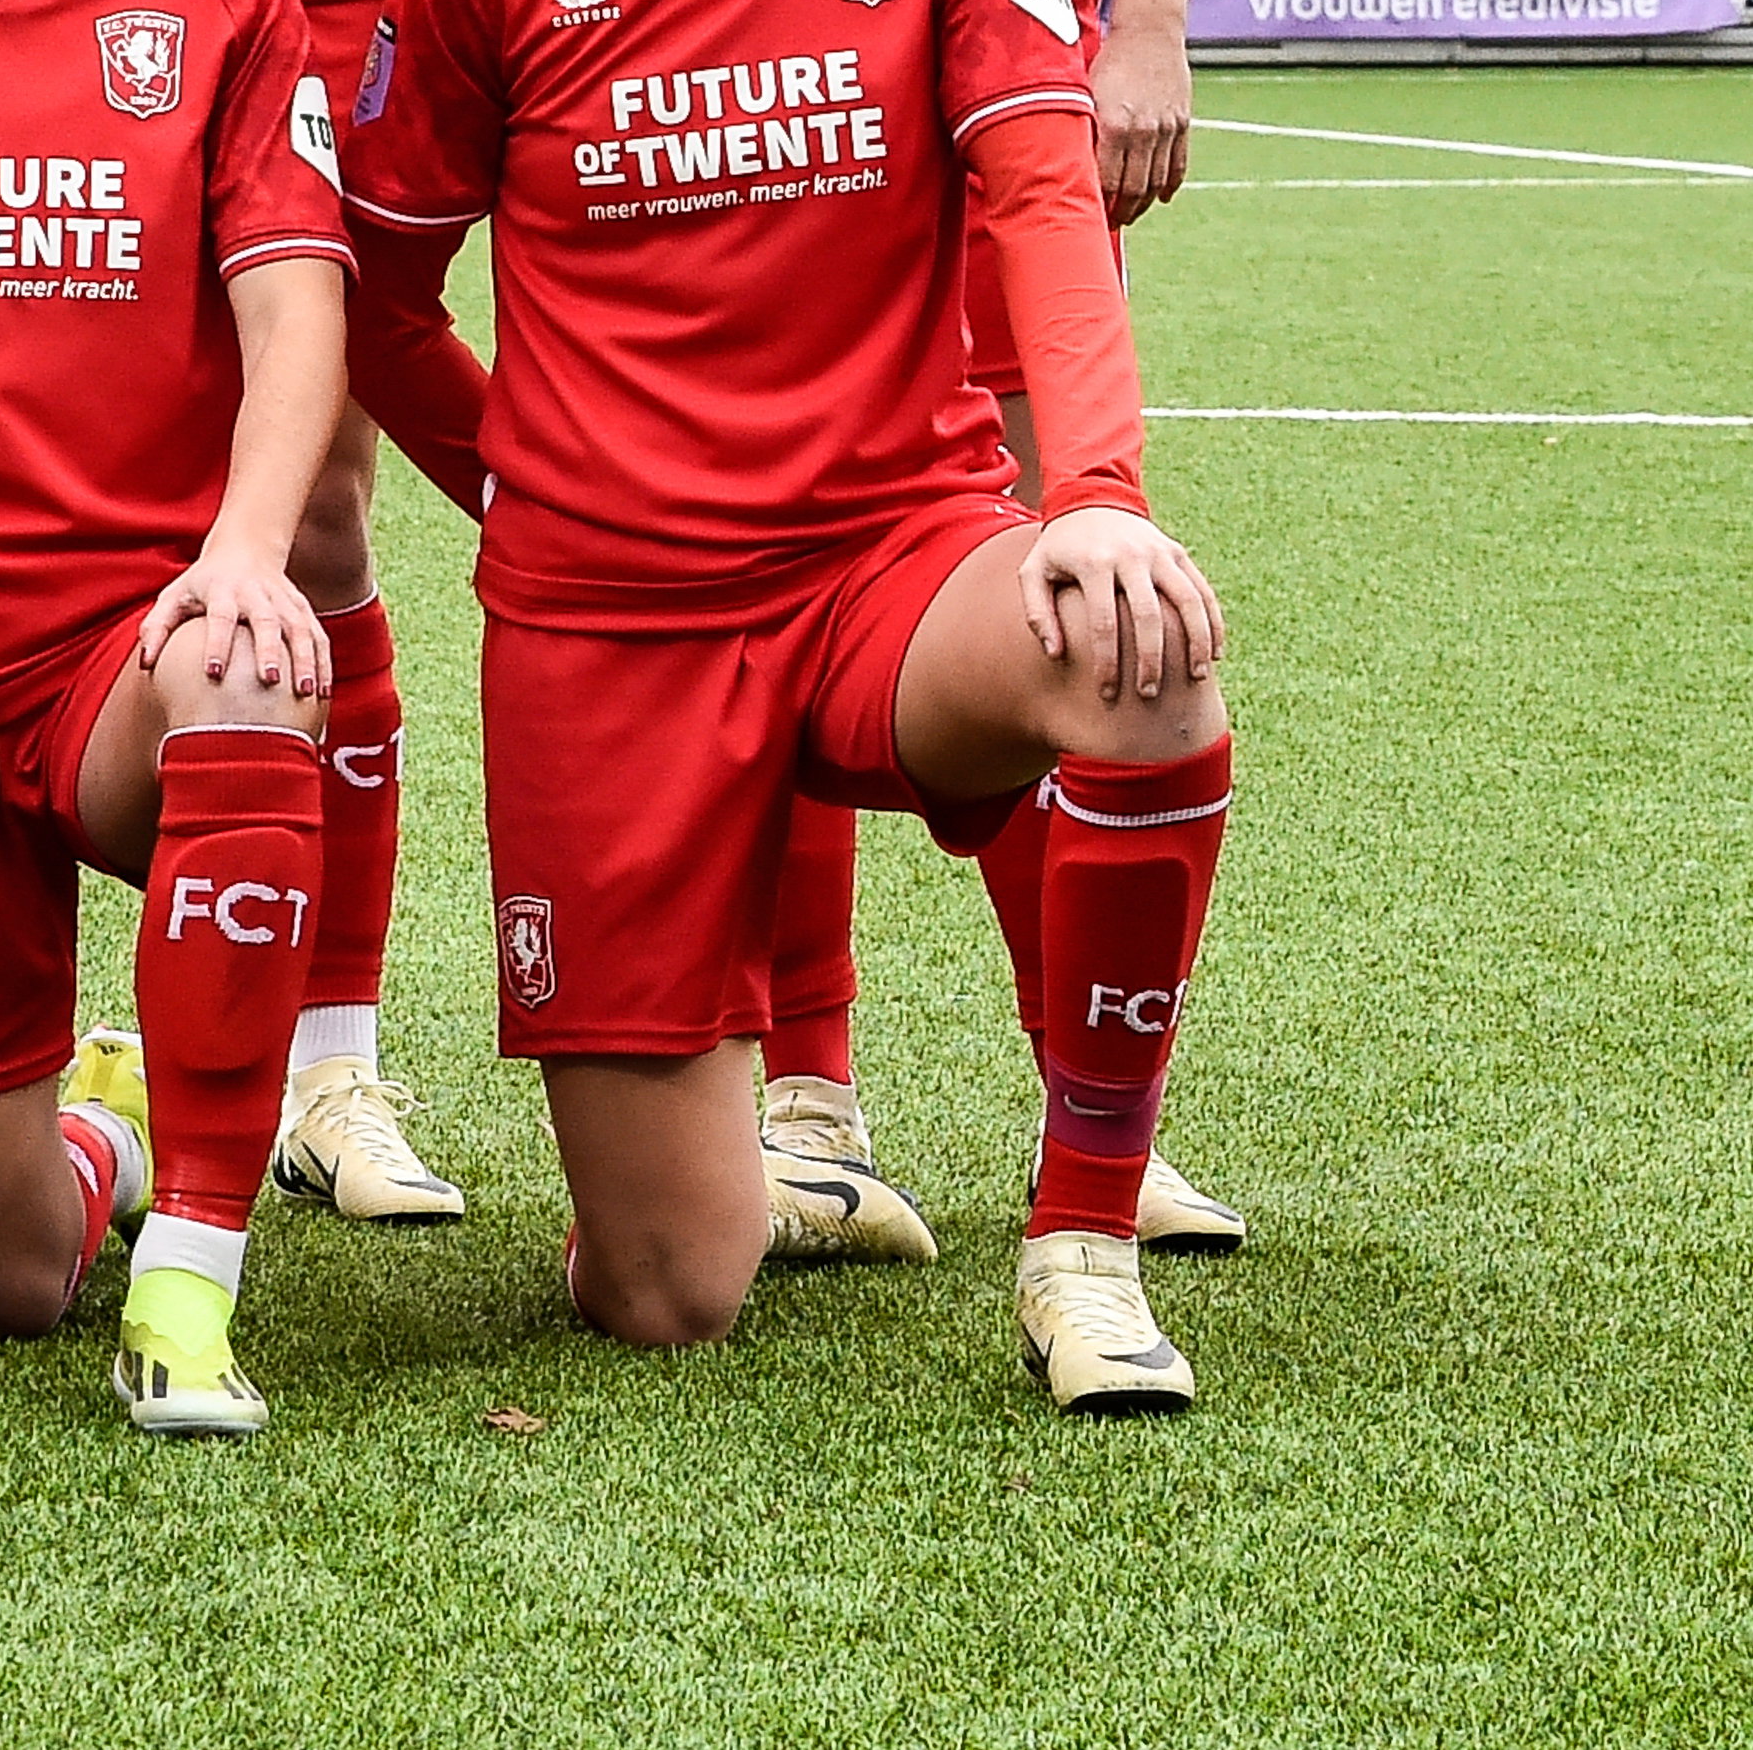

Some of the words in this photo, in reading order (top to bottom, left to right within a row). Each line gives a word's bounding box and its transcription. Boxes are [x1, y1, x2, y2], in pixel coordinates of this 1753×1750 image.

[610, 49, 864, 132] FUTURE
[300, 113, 334, 151] TO
[574, 141, 627, 186] OF
[625, 106, 888, 189] TWENTE
[587, 198, 641, 222] meer
[644, 187, 745, 217] vrouwen.
[749, 177, 809, 204] meer
[812, 165, 890, 198] kracht.
[61, 274, 140, 301] kracht.
